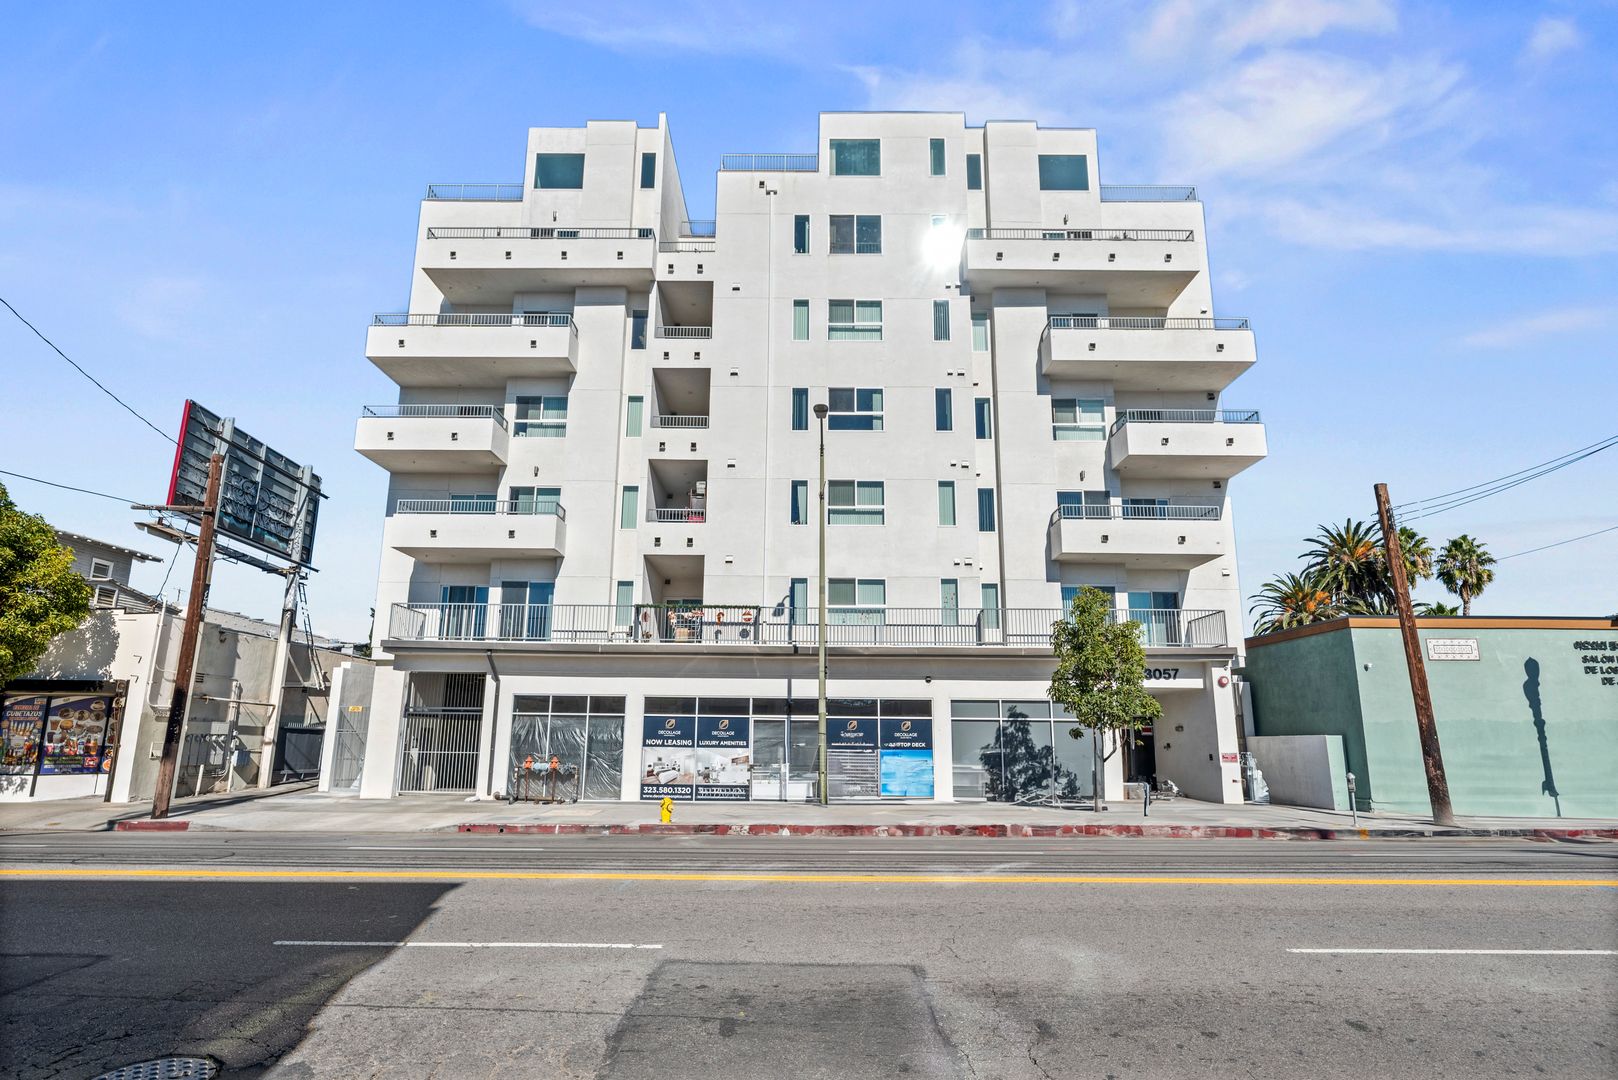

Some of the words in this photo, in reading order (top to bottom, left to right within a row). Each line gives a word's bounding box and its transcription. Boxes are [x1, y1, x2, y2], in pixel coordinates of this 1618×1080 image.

[1144, 668, 1179, 680] 3057
[1584, 666, 1598, 674] DE
[1601, 677, 1616, 685] DE
